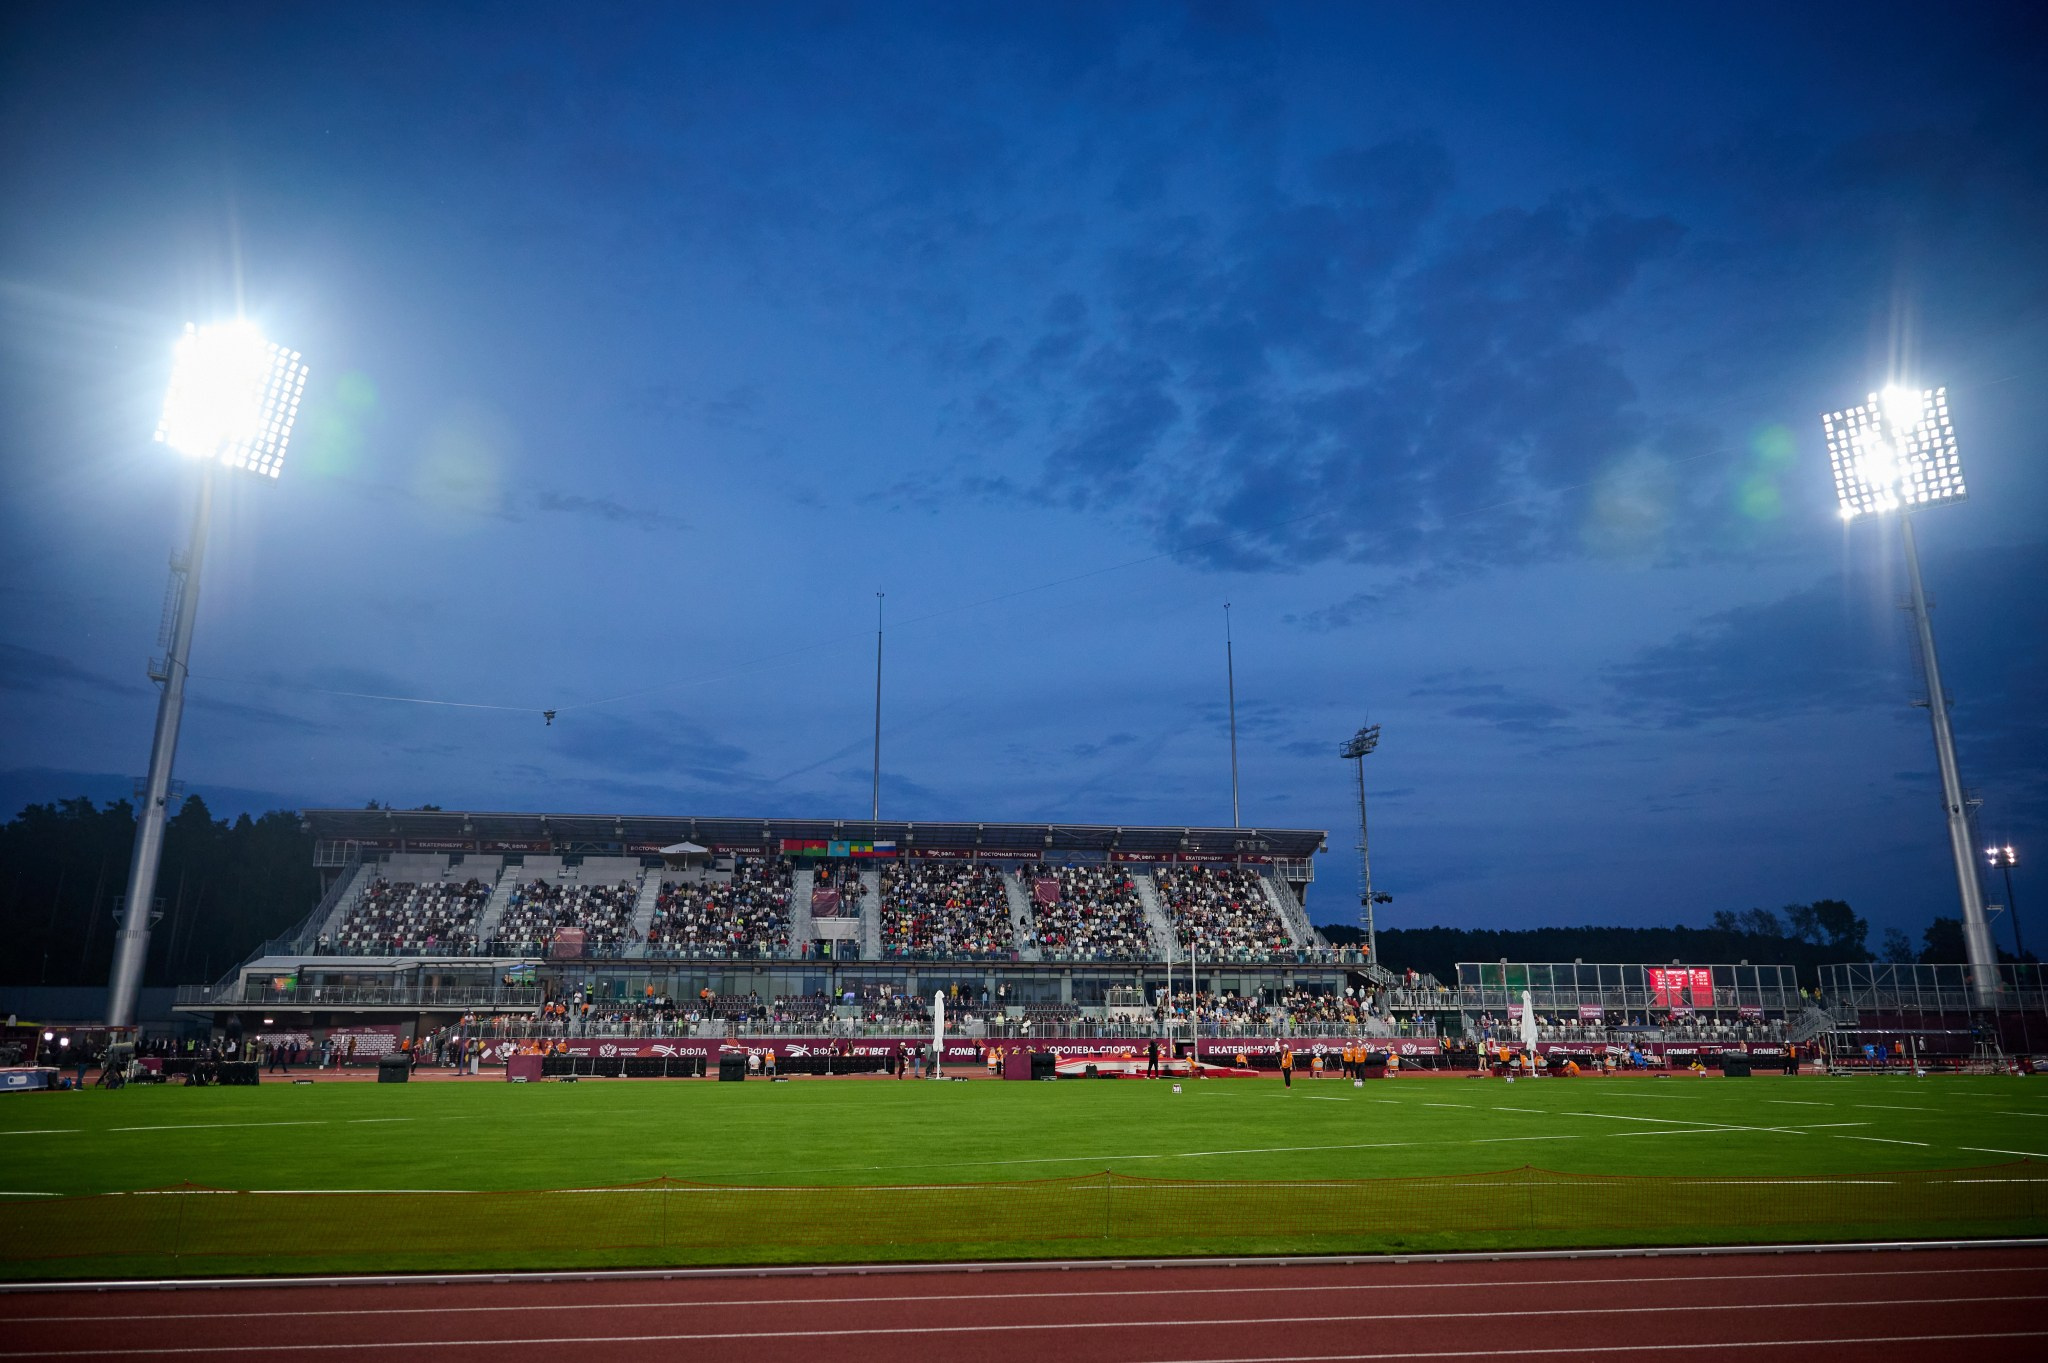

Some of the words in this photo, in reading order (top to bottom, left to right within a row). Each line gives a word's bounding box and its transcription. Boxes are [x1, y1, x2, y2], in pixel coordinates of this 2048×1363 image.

[680, 1047, 708, 1056] ВФЛА
[1049, 1046, 1094, 1054] ОРОЛЕВА
[1099, 1046, 1137, 1054] СПОРТА
[1208, 1046, 1275, 1054] ЕКАТЕРИНБУР
